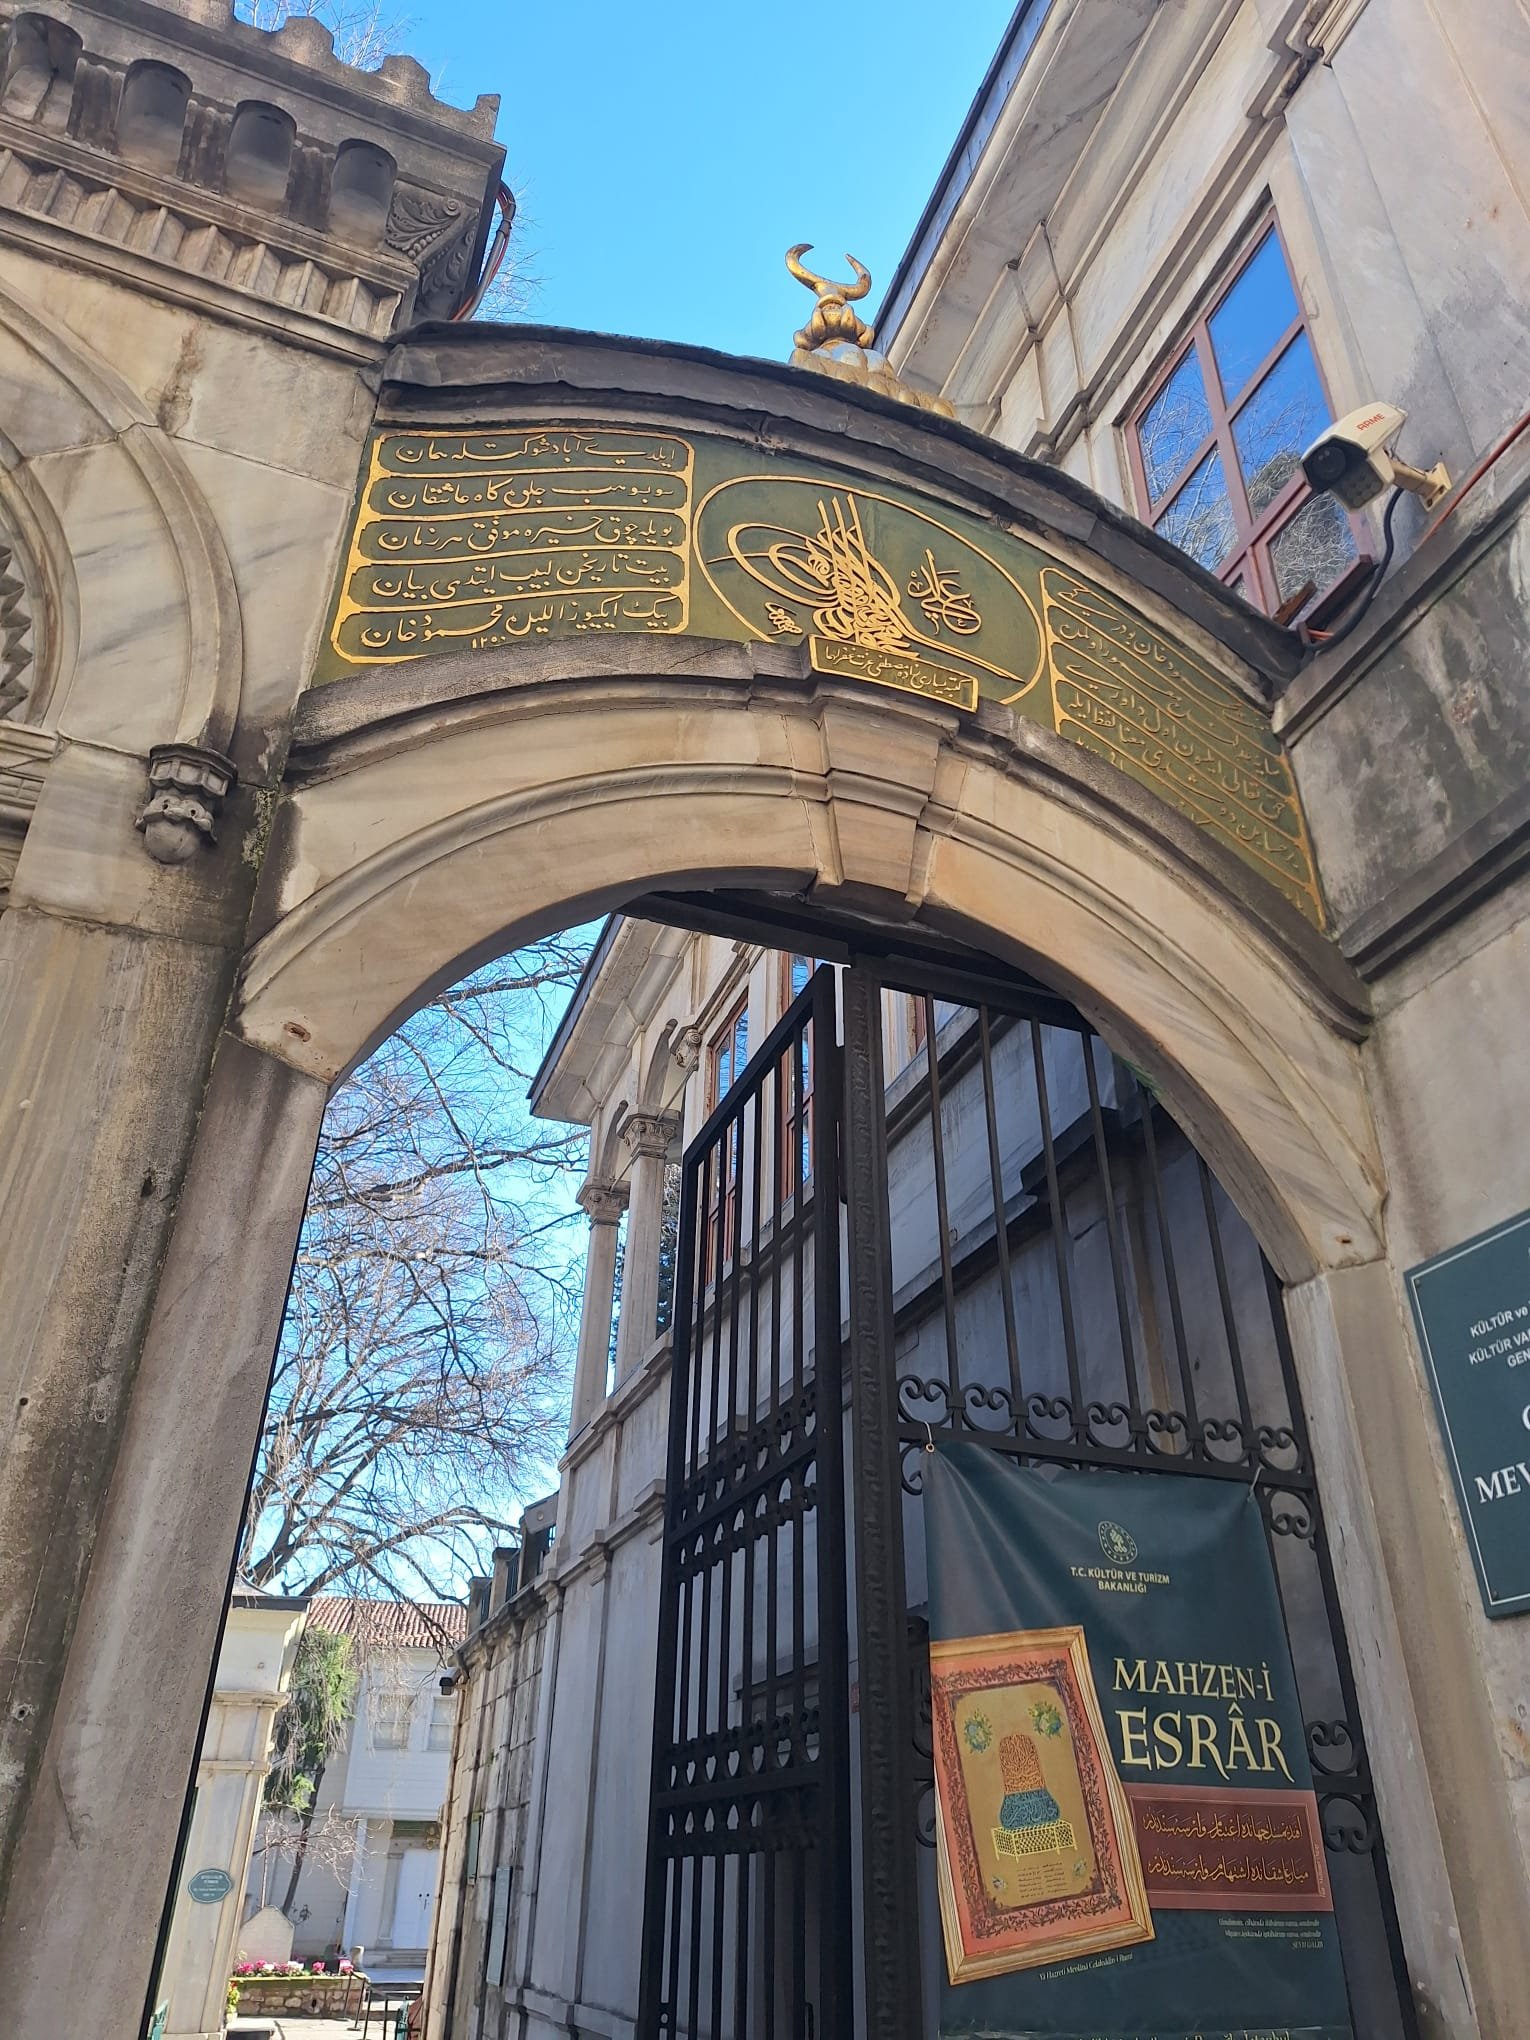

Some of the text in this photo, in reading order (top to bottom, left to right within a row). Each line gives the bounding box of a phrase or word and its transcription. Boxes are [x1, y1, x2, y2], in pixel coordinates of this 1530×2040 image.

[1470, 1306, 1528, 1338] KÜLTÜR ve
[1468, 1338, 1513, 1365] KÜLTÜR
[1070, 1566, 1170, 1584] T.C. KÜLTÜR VE TURİZM
[1098, 1580, 1147, 1593] BAKANLIĞI
[1112, 1657, 1275, 1701] MAHZEN-İ
[1114, 1700, 1296, 1784] ESRÂR
